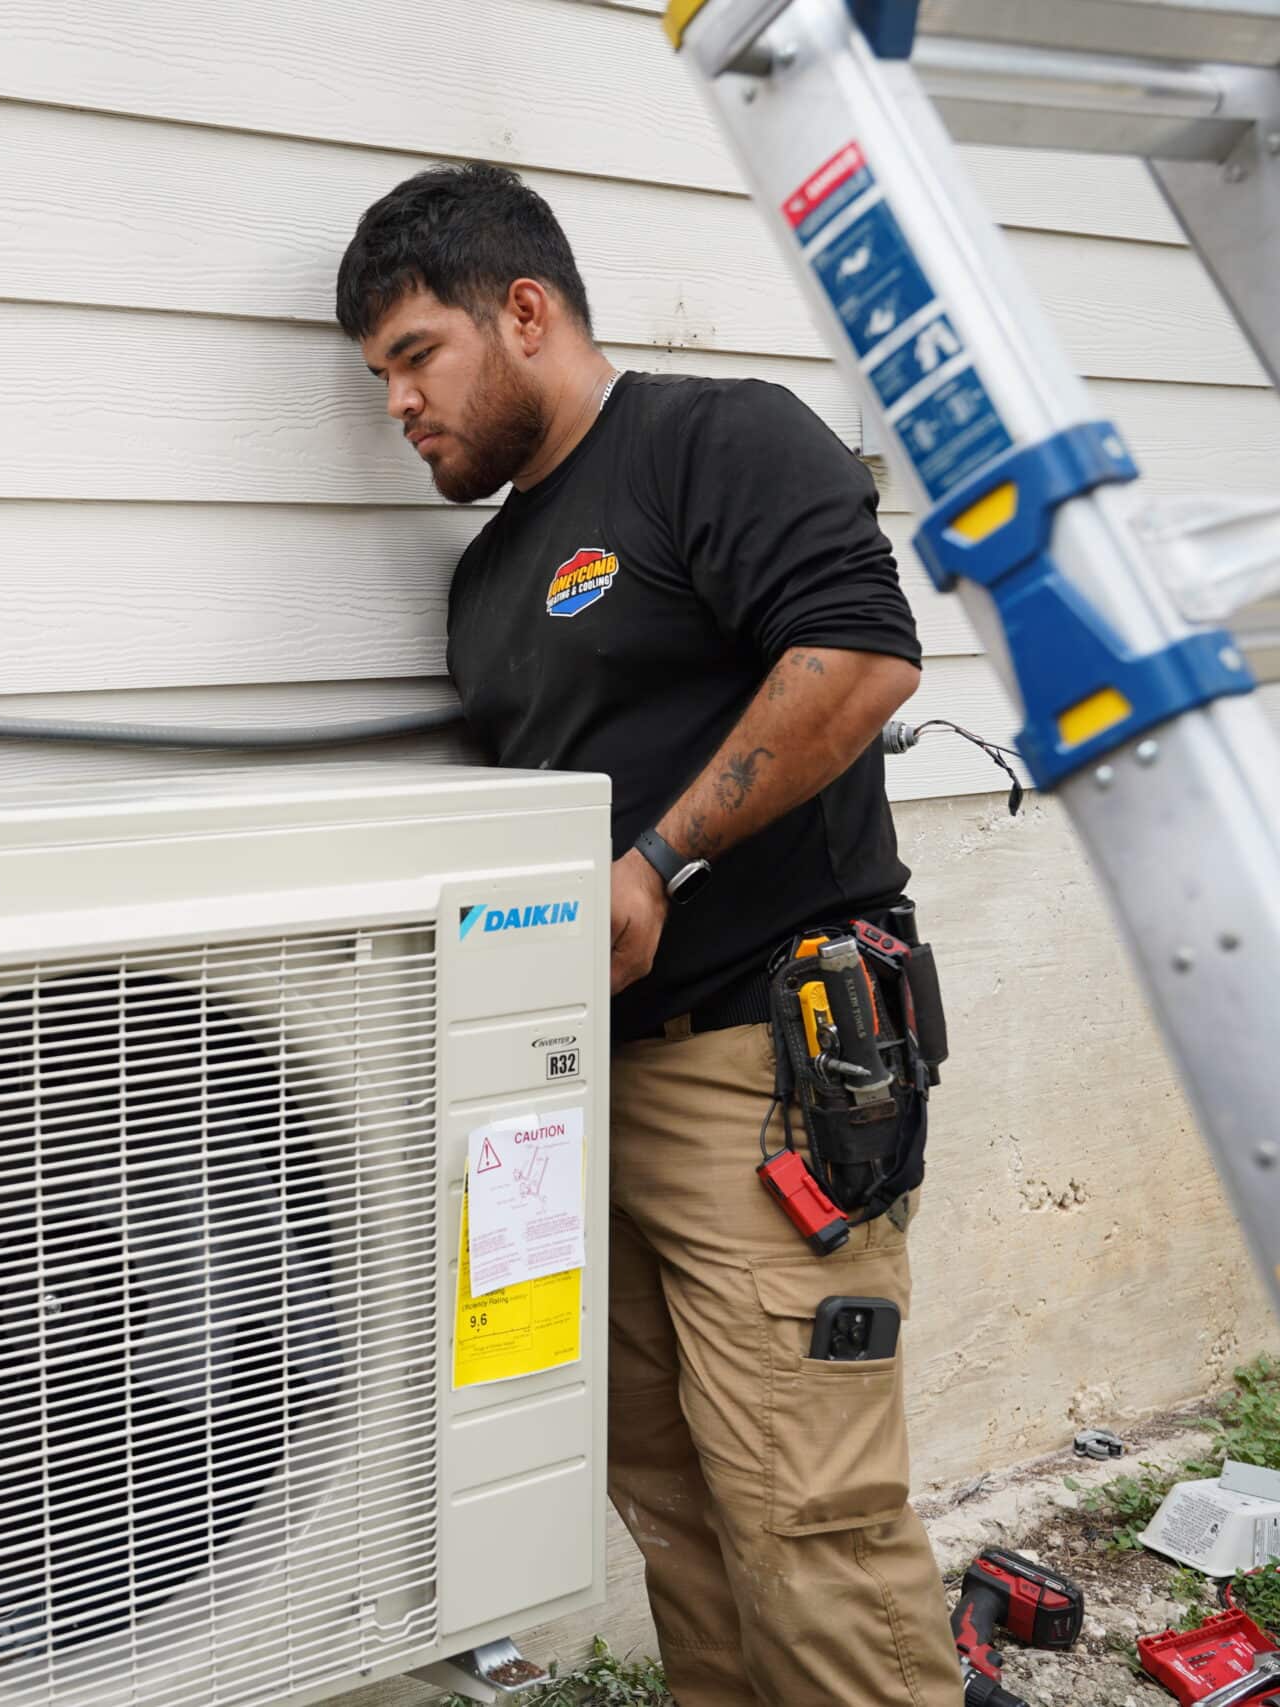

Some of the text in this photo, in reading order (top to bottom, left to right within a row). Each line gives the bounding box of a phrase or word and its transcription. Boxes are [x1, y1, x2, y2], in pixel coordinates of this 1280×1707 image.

[578, 575, 609, 593] COOLING
[483, 900, 579, 932] DAIKIN
[538, 1036, 570, 1047] INVERTER
[549, 1053, 577, 1077] R32
[514, 1123, 566, 1145] CAUTION
[470, 1312, 488, 1329] 9.6
